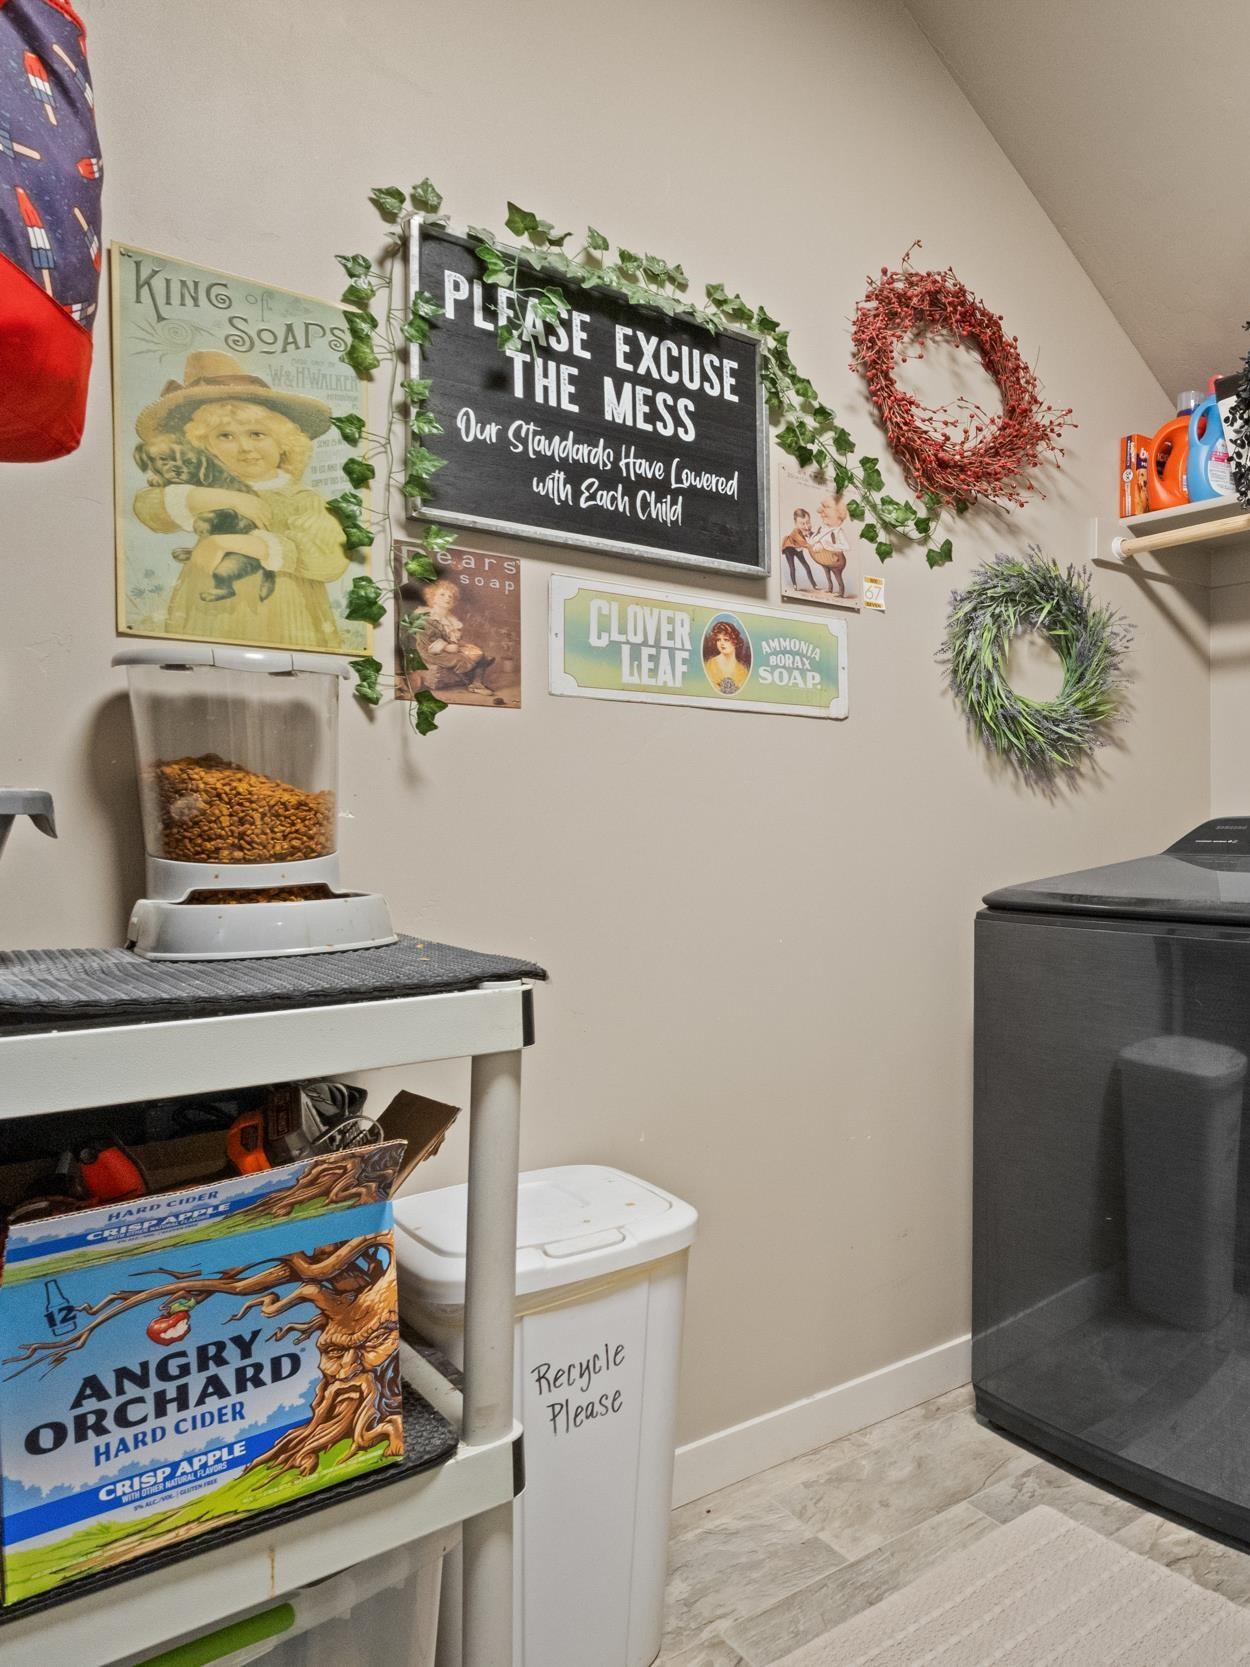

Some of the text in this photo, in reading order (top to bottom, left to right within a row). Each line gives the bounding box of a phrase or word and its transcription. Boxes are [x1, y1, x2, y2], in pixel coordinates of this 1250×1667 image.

[133, 259, 232, 323] KING
[224, 316, 348, 355] SOAPS
[444, 269, 739, 403] PLEASE EXCUSE
[505, 349, 696, 442] THE MESS
[456, 407, 739, 500] Our Standards Have Lowered
[532, 469, 683, 527] with Each Child
[460, 574, 515, 594] soap
[864, 585, 882, 602] 67
[588, 598, 692, 650] CLOVER
[621, 643, 690, 688] LEAF
[761, 637, 821, 661] AMMONIA
[769, 655, 811, 670] BORAX
[86, 1219, 157, 1240] CRISP
[161, 1203, 231, 1225] APPLE
[107, 1190, 219, 1221] HARD CIDER
[44, 1304, 78, 1329] 12
[69, 1328, 263, 1411] ANGRY
[530, 1343, 625, 1395] Recycle
[24, 1352, 302, 1456] ORCHARD
[546, 1390, 623, 1436] Please
[94, 1401, 246, 1467] HARD CIDER
[98, 1441, 247, 1501] CRISP APPLE
[122, 1461, 228, 1503] WITH OTHER NATURAL FLAVORS
